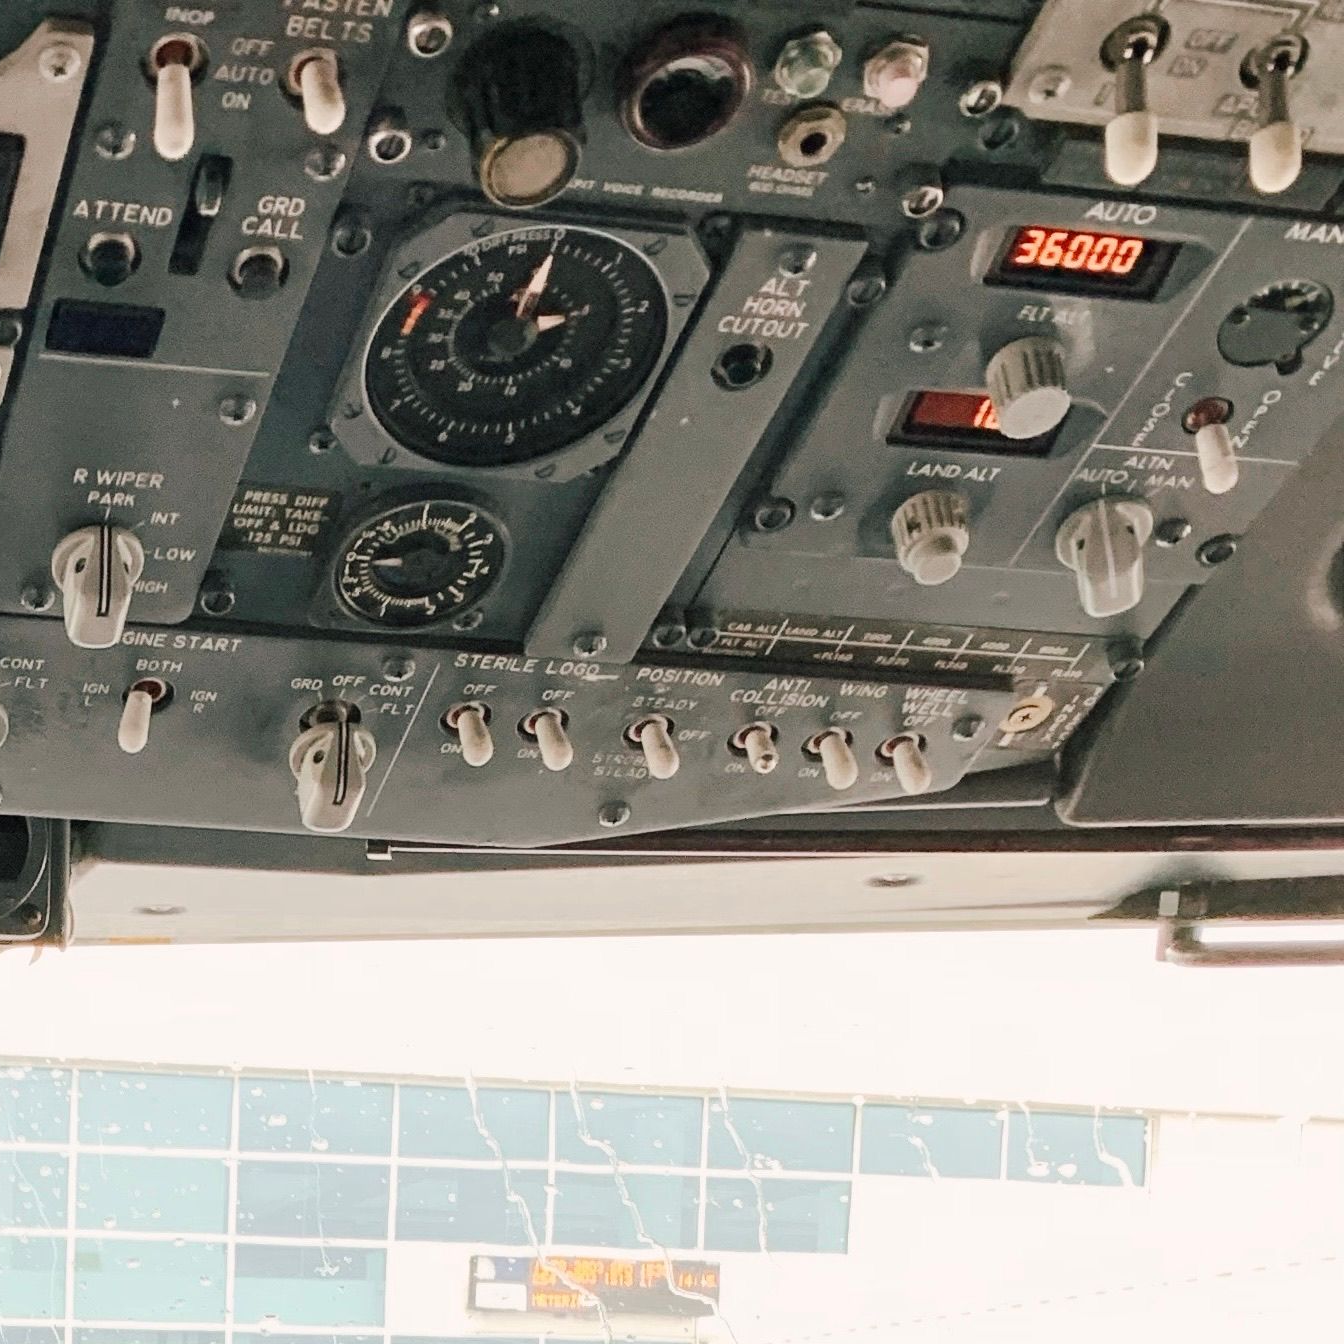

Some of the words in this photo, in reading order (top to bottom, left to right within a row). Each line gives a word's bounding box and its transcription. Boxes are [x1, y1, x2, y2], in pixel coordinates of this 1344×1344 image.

[287, 17, 373, 43] BELTS
[214, 65, 275, 84] AUTO
[73, 200, 172, 226] ATTEND
[258, 197, 305, 217] GRD
[1084, 203, 1156, 224] AUTO
[242, 217, 302, 240] CALL
[1015, 230, 1142, 274] 36000
[759, 278, 811, 296] ALT
[744, 297, 803, 317] HORN
[718, 317, 809, 338] CUTOUT
[74, 469, 86, 485] R
[97, 470, 163, 489] WIPER
[907, 462, 962, 478] LAND
[964, 465, 1002, 482] ALT
[88, 491, 135, 506] PARK
[151, 512, 179, 524] INT
[154, 548, 196, 561] LOW
[137, 659, 182, 672] BOTH
[456, 655, 535, 675] STERILE
[546, 661, 599, 679] LOGO
[637, 668, 724, 688] POSITION
[765, 678, 811, 694] ANTI
[730, 689, 828, 709] COLLISION
[840, 683, 888, 699] WING
[904, 686, 967, 704] WHEEL
[903, 702, 952, 718] WELL
